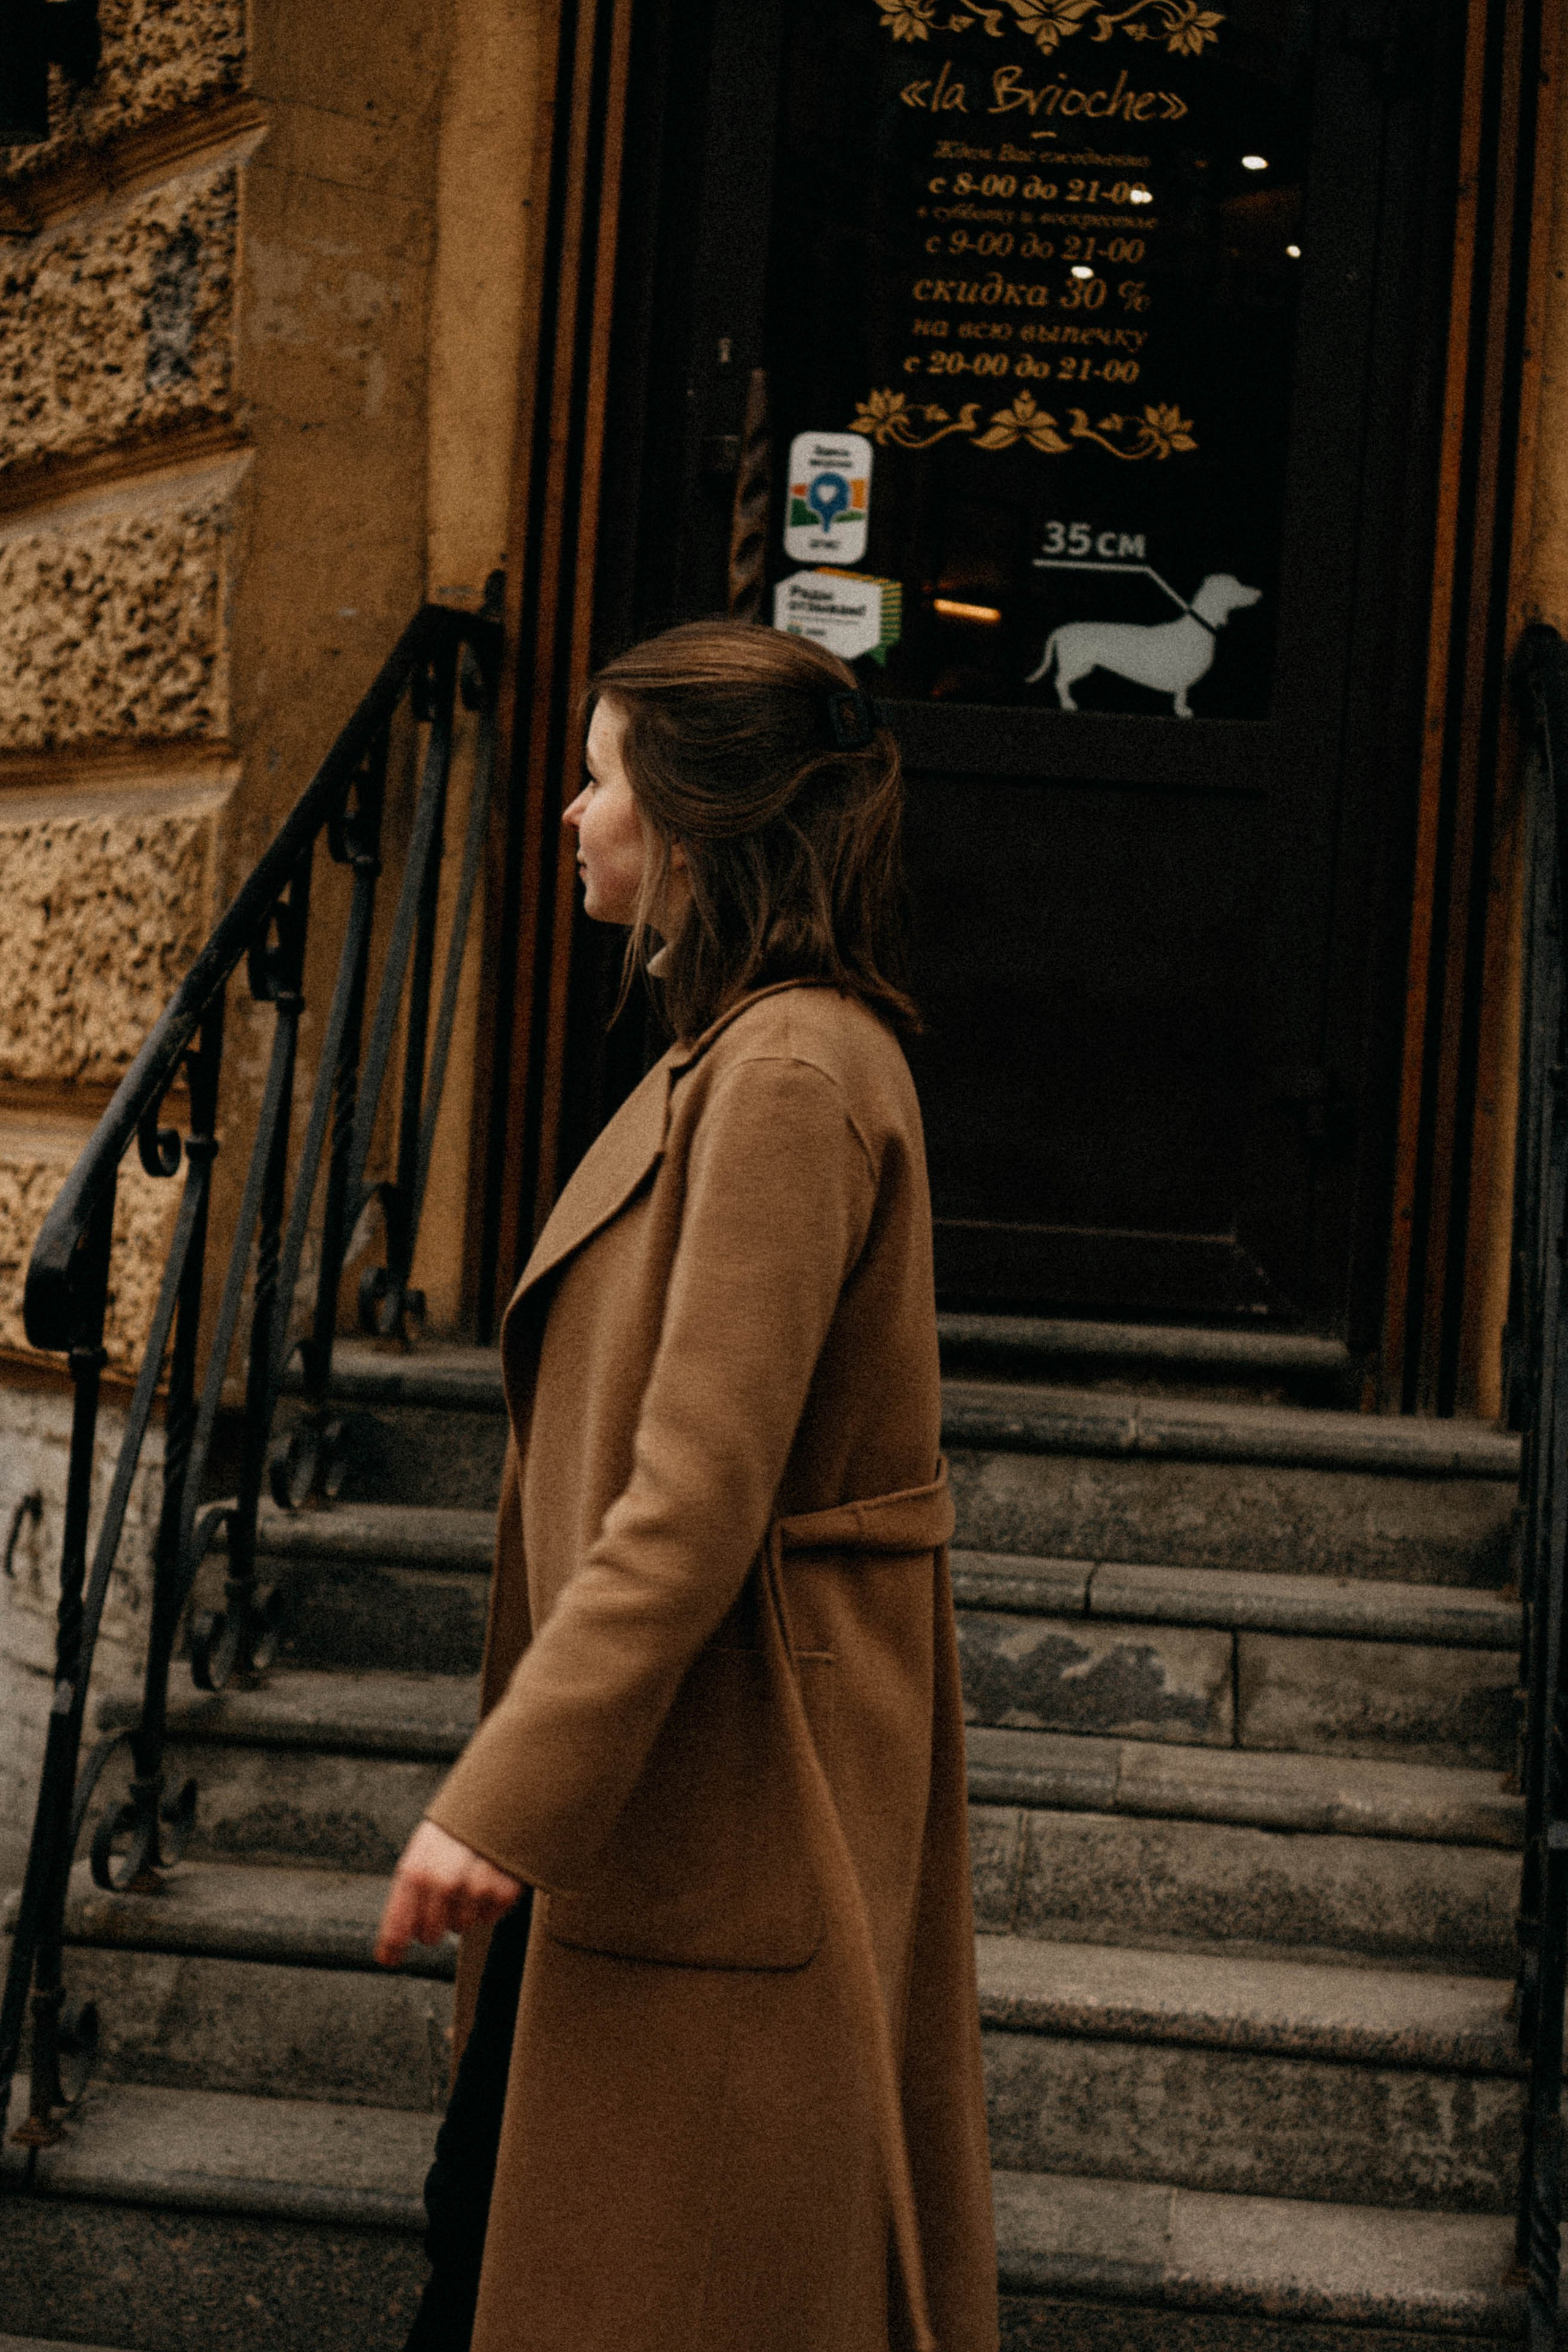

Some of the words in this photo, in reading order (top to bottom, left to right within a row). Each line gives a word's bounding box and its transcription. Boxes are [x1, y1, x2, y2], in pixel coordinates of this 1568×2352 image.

[928, 176, 948, 194] с
[952, 172, 1018, 198] 8-00
[1022, 175, 1058, 200] до
[924, 234, 943, 254] с
[948, 229, 1015, 258] 9-00
[1019, 232, 1055, 260] до
[1060, 235, 1145, 264] 21-00
[913, 271, 1049, 308] скидка
[1060, 277, 1108, 310] 30
[1118, 279, 1152, 313] %
[911, 318, 949, 337] на
[957, 320, 1013, 341] всю
[1020, 323, 1149, 354] выпечку
[902, 355, 922, 373] с
[926, 350, 1010, 377] 20-00
[1014, 353, 1051, 379] до
[1057, 356, 1140, 385] 21-00
